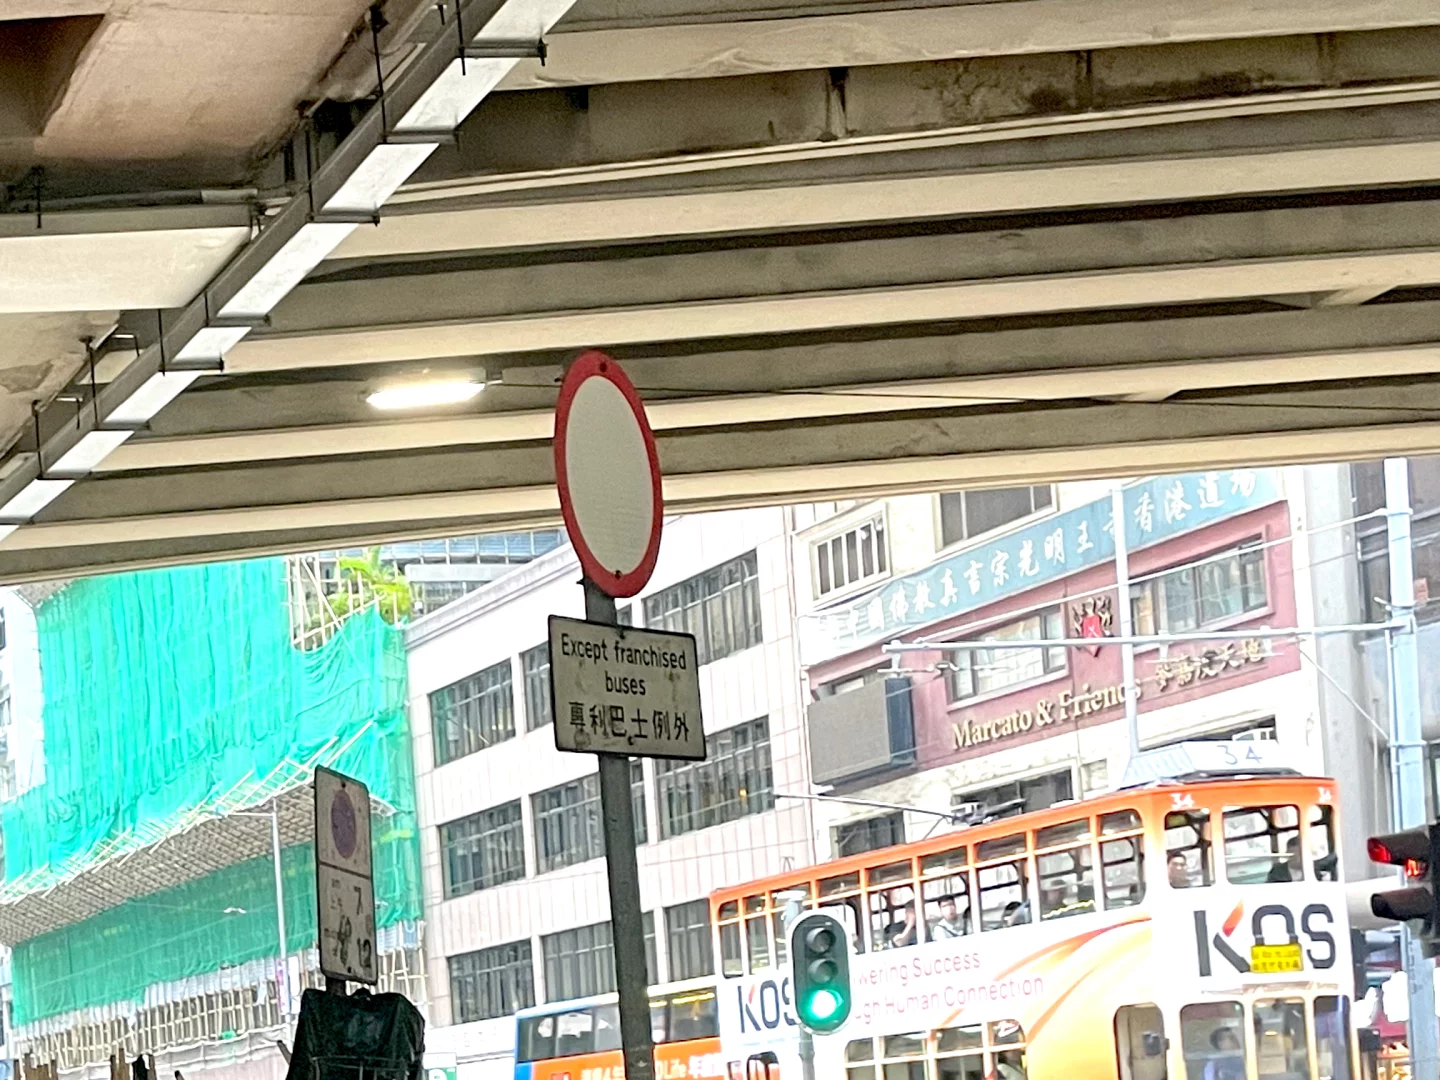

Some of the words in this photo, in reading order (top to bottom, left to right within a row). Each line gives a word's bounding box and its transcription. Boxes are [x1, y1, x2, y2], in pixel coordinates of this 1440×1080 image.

[561, 633, 608, 665] Except
[614, 641, 687, 670] franchised
[605, 670, 646, 695] buses
[951, 708, 1033, 750] Marcato
[1035, 698, 1056, 724] &
[1169, 792, 1195, 810] 34
[1193, 899, 1337, 977] KOS
[912, 950, 981, 978] Success
[944, 975, 1045, 1008] Connection
